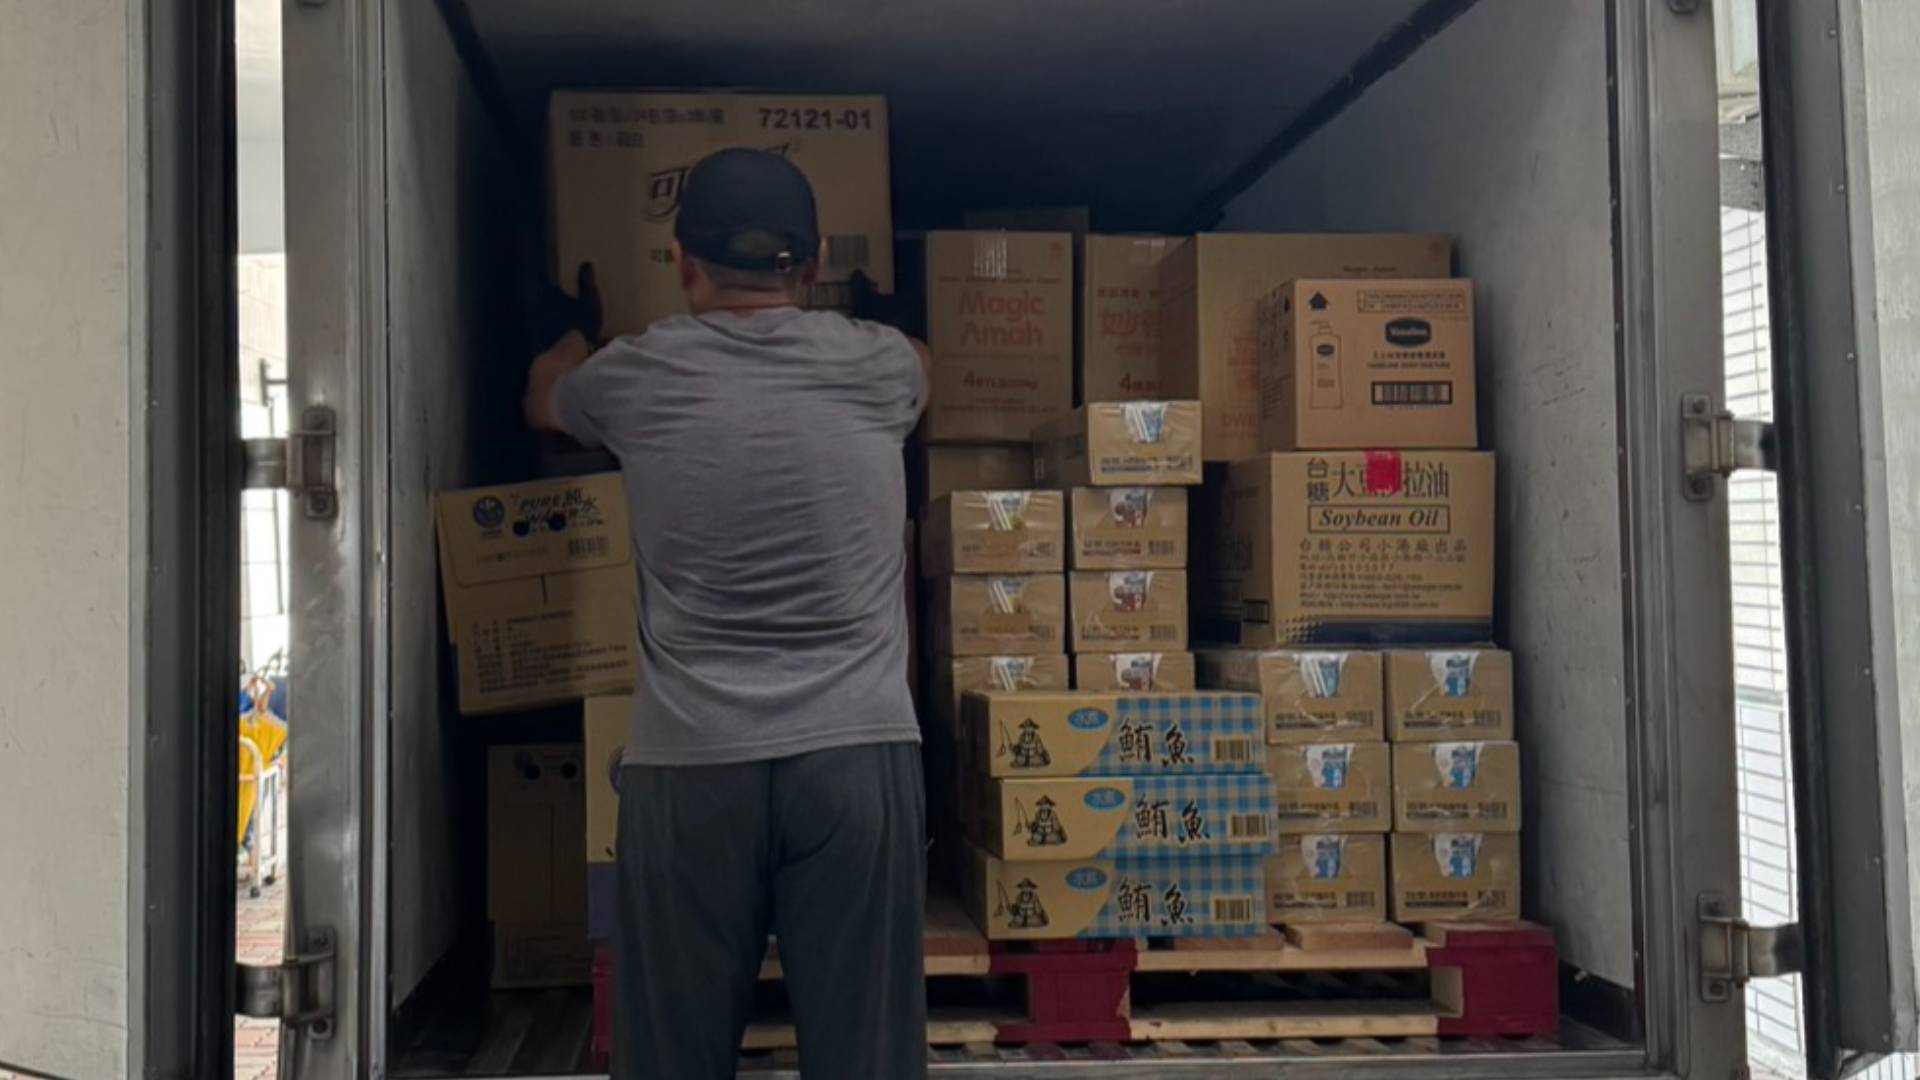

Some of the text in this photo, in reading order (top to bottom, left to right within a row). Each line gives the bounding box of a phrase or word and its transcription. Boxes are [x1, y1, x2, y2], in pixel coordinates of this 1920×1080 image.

[758, 107, 872, 130] 72121-01
[959, 289, 1045, 322] Magic
[960, 320, 1044, 347] Amah
[1332, 460, 1449, 499] 大拉油
[1318, 508, 1440, 531] Soybean Oil
[1117, 718, 1195, 767] 鮪魚
[1134, 793, 1211, 843] 鮪魚
[1117, 876, 1194, 927] 鮪魚
